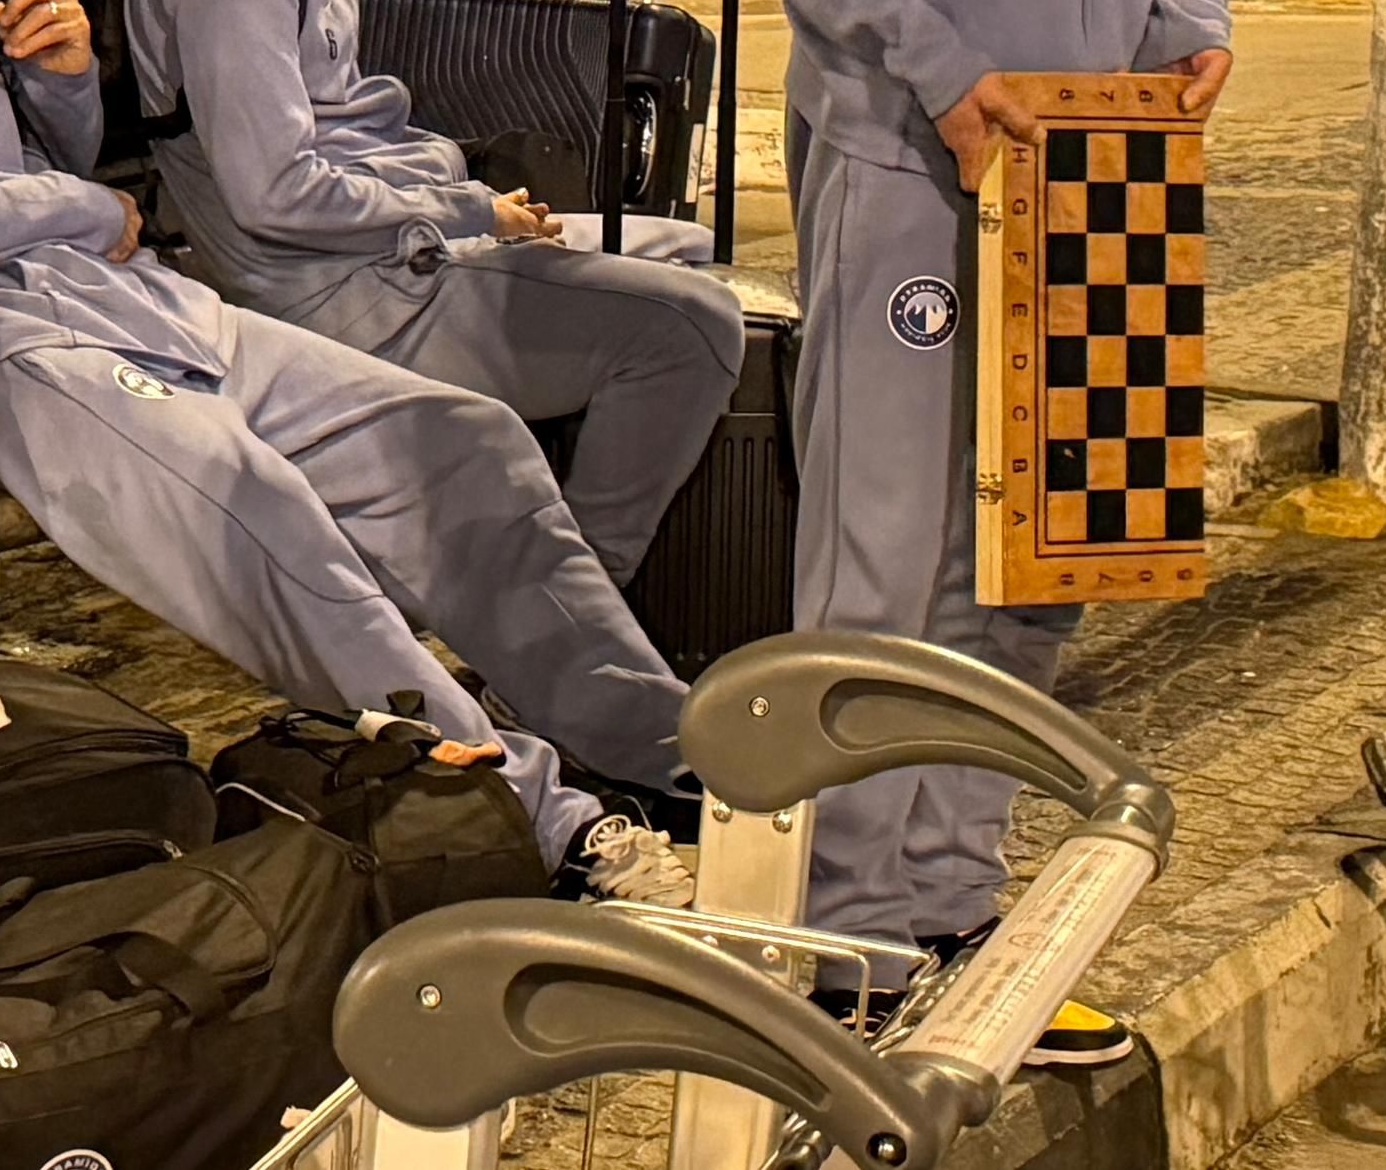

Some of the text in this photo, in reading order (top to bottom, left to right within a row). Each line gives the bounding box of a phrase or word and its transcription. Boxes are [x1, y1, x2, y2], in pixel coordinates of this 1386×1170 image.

[325, 28, 338, 61] 6
[1012, 353, 1029, 371] D
[1012, 405, 1029, 422] C
[1012, 458, 1029, 474] B
[1012, 509, 1028, 527] A
